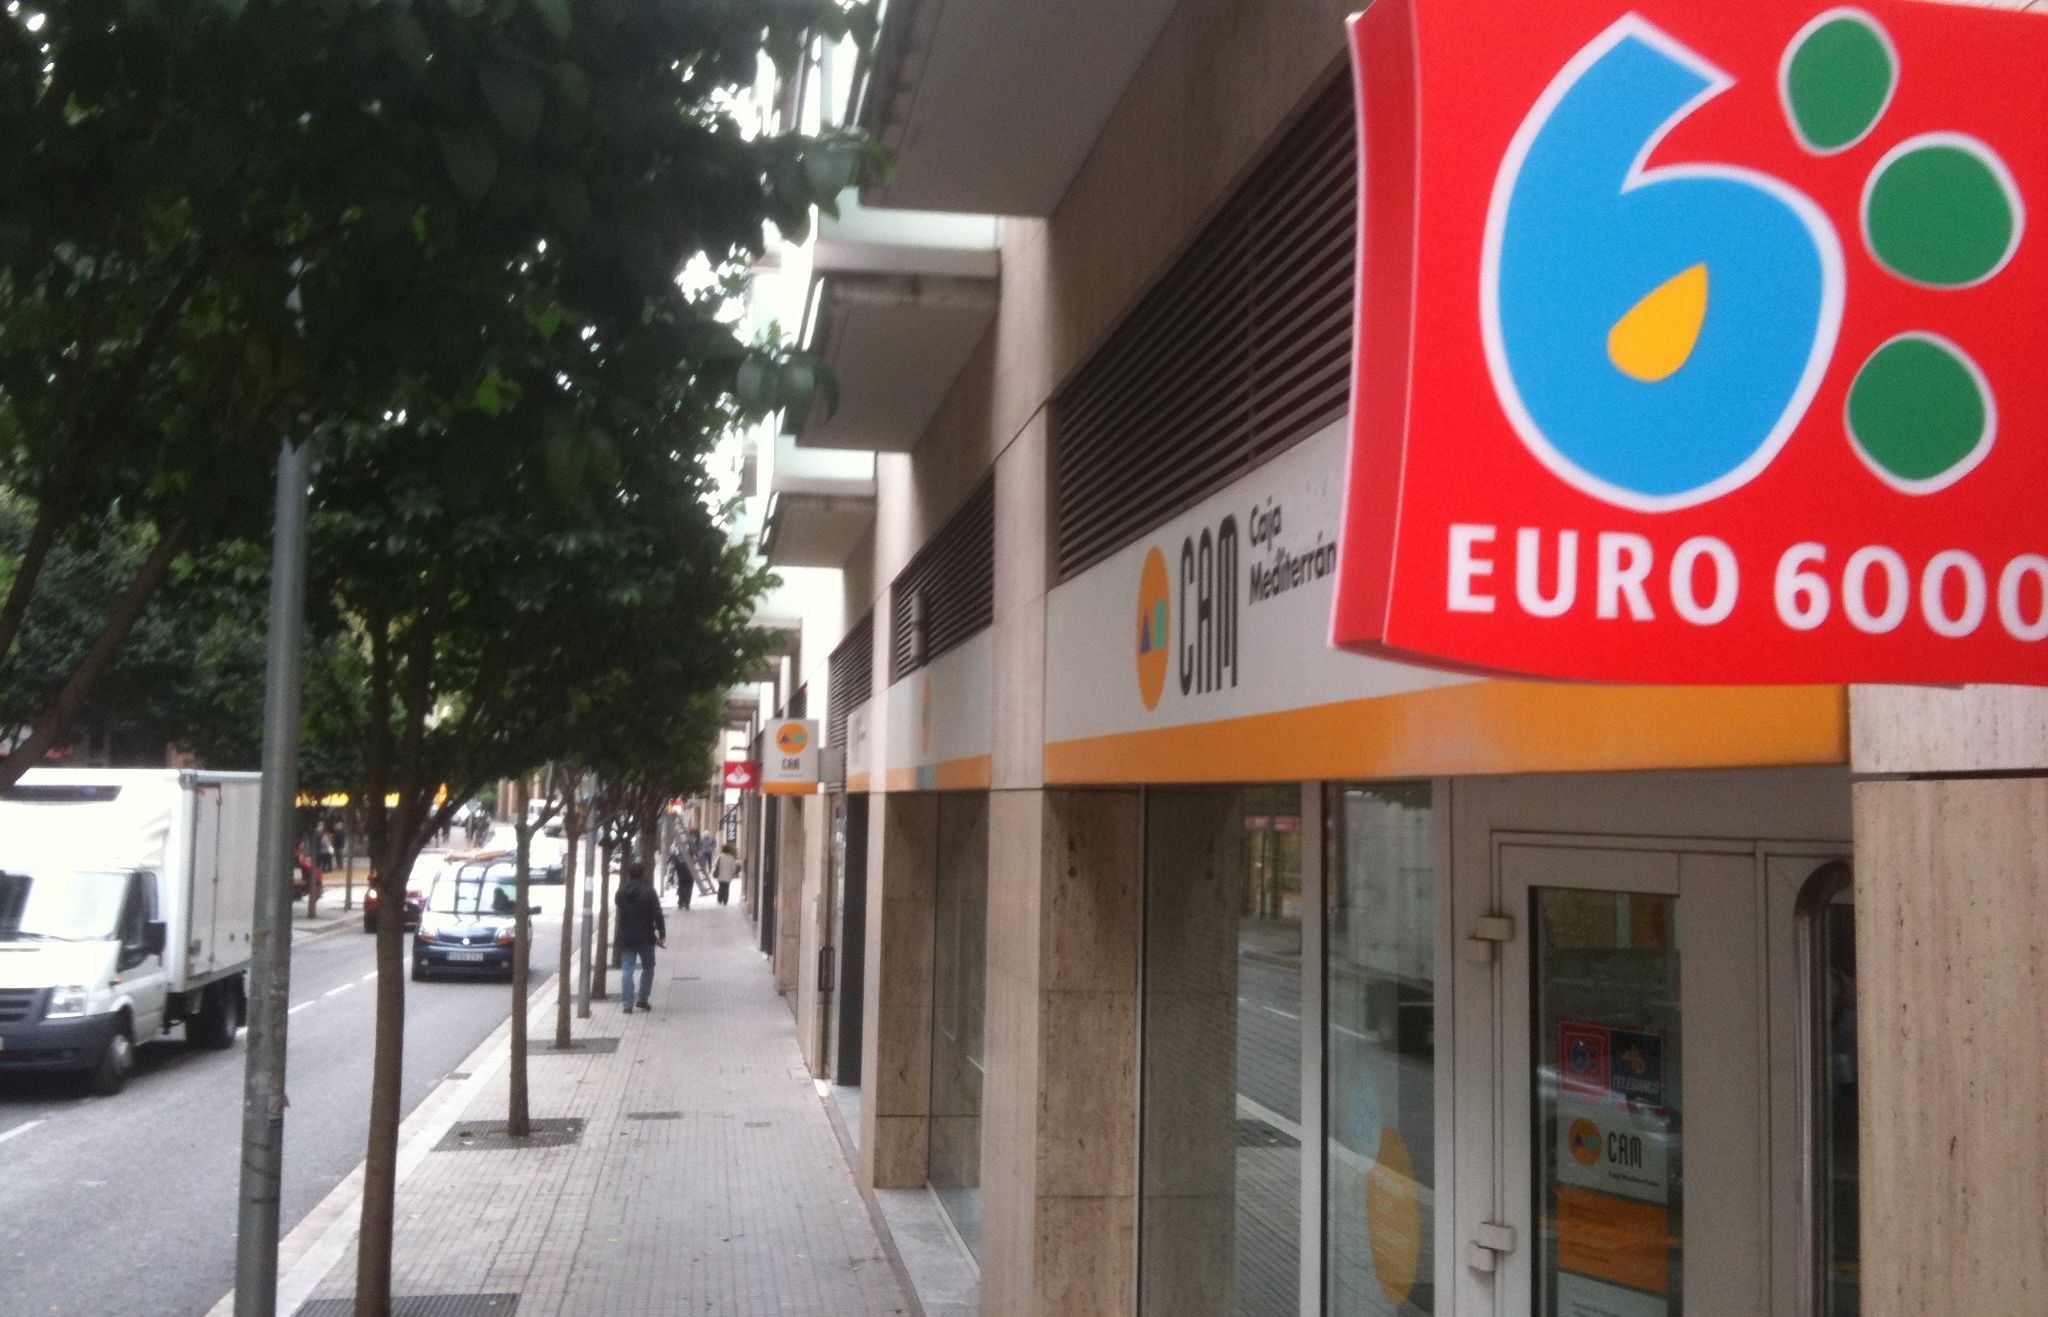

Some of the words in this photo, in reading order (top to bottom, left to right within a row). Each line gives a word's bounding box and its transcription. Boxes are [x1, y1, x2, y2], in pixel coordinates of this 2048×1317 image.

[1249, 495, 1282, 552] Caja
[1178, 513, 1239, 697] CAM
[1445, 522, 1740, 626] EURO
[1773, 541, 2048, 643] 6000
[1608, 1131, 1642, 1168] CAM
